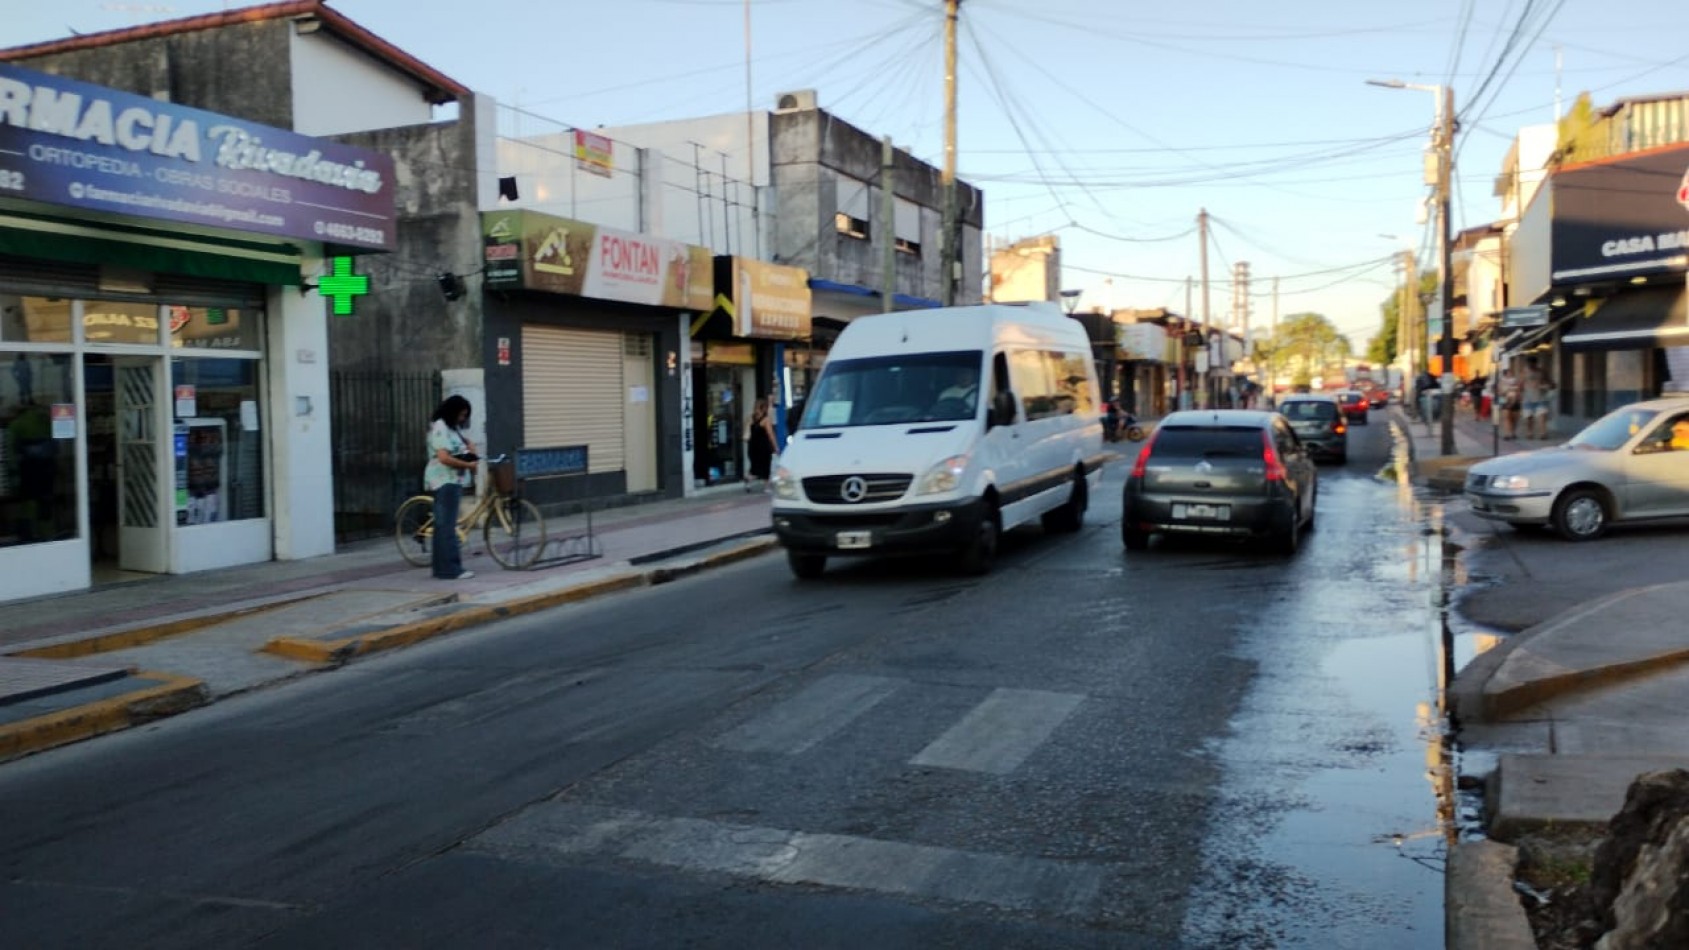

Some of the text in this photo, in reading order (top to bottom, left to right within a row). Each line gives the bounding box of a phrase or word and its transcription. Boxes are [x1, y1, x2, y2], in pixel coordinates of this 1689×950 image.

[29, 144, 142, 178] ORTOPEDIA
[155, 167, 214, 189] OBRAS
[218, 178, 292, 203] SOCIALES
[602, 235, 660, 276] FONTAN
[1602, 235, 1656, 257] CASA
